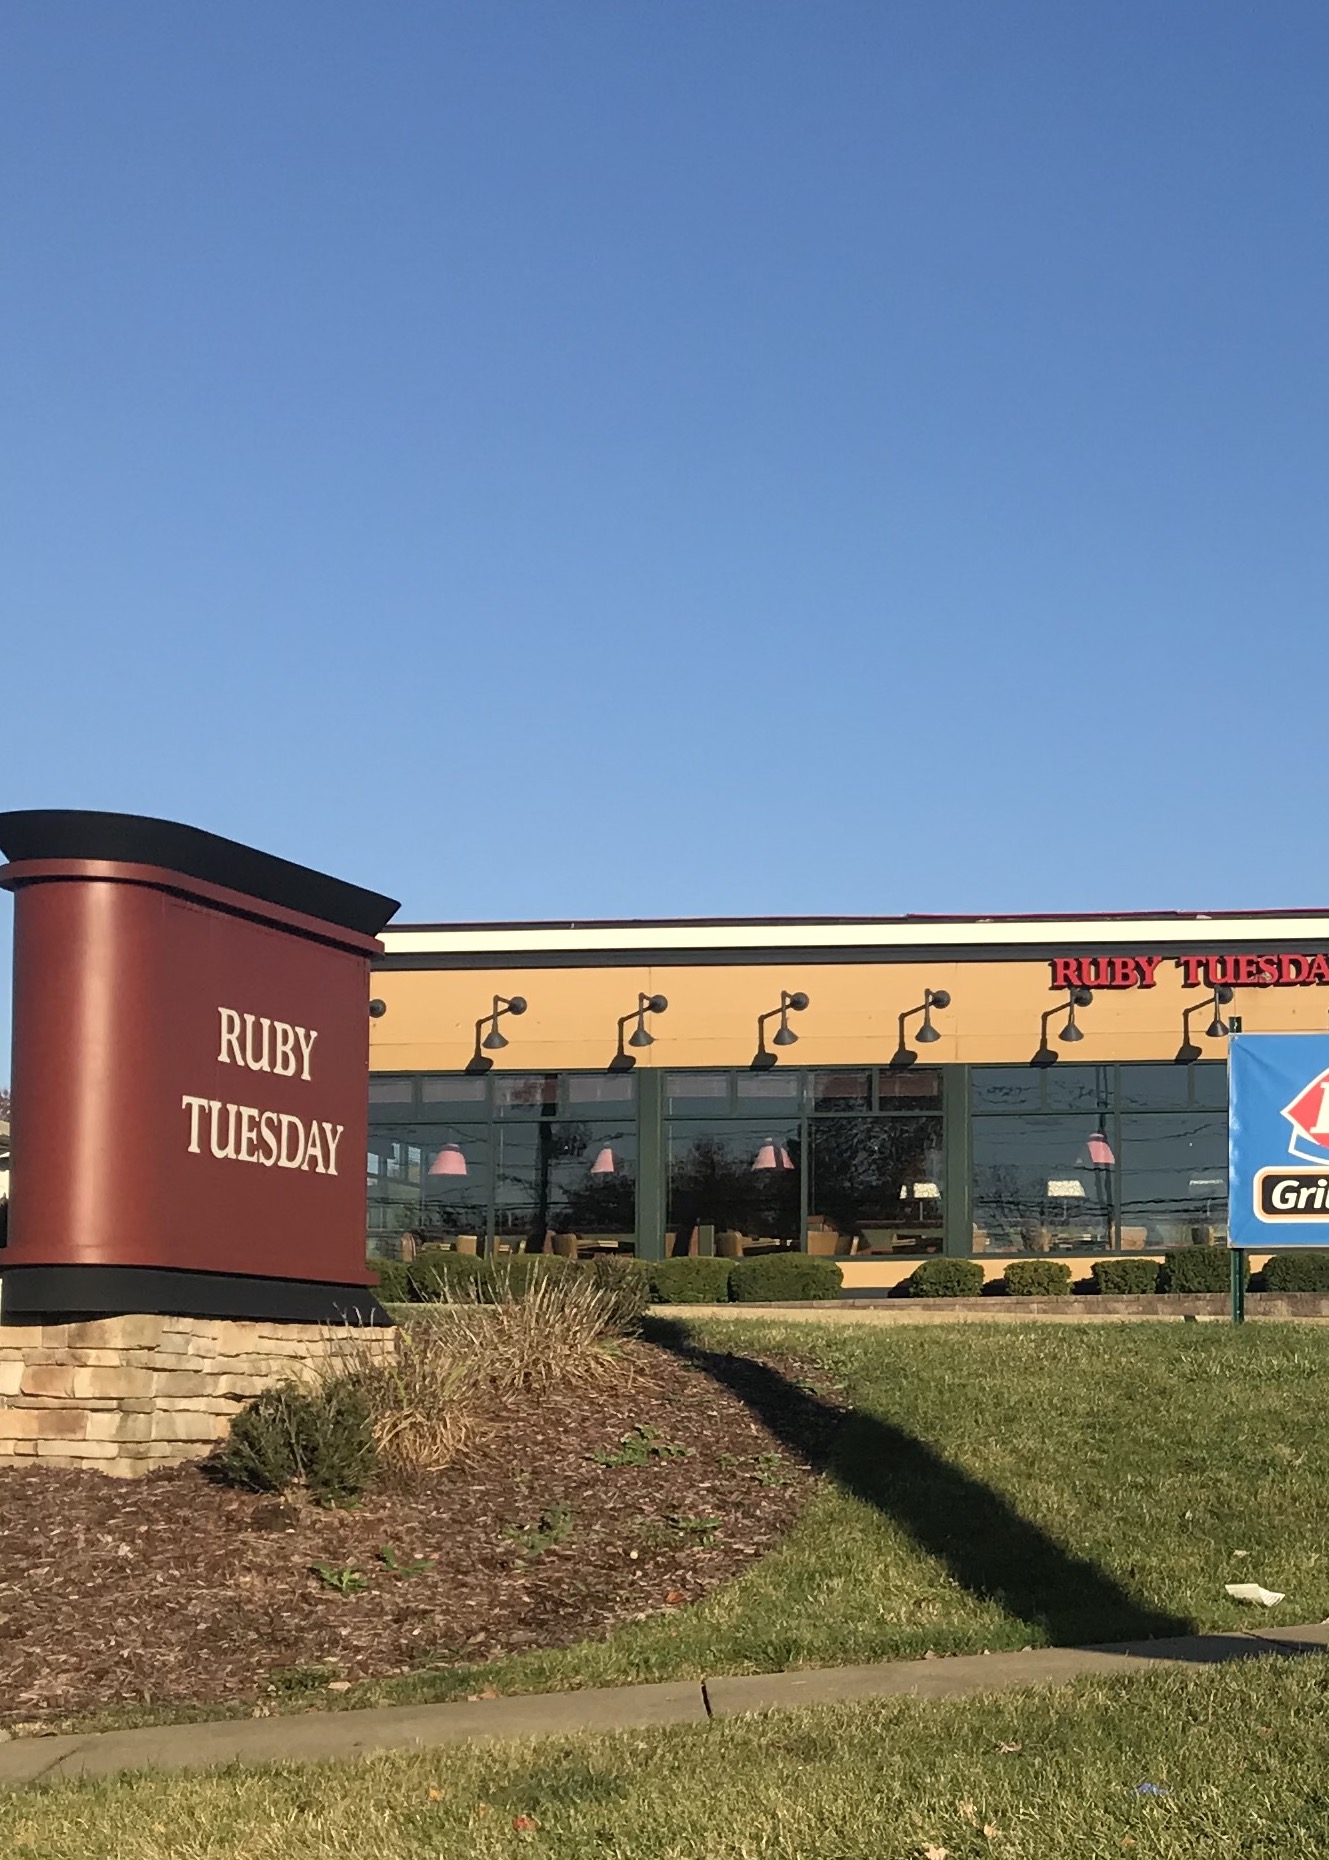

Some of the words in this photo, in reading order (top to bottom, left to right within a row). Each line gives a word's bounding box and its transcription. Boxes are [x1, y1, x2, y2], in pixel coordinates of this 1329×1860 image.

[1049, 956, 1162, 990] RUBY
[217, 1006, 318, 1081] RUBY
[181, 1094, 344, 1175] TUESDAY
